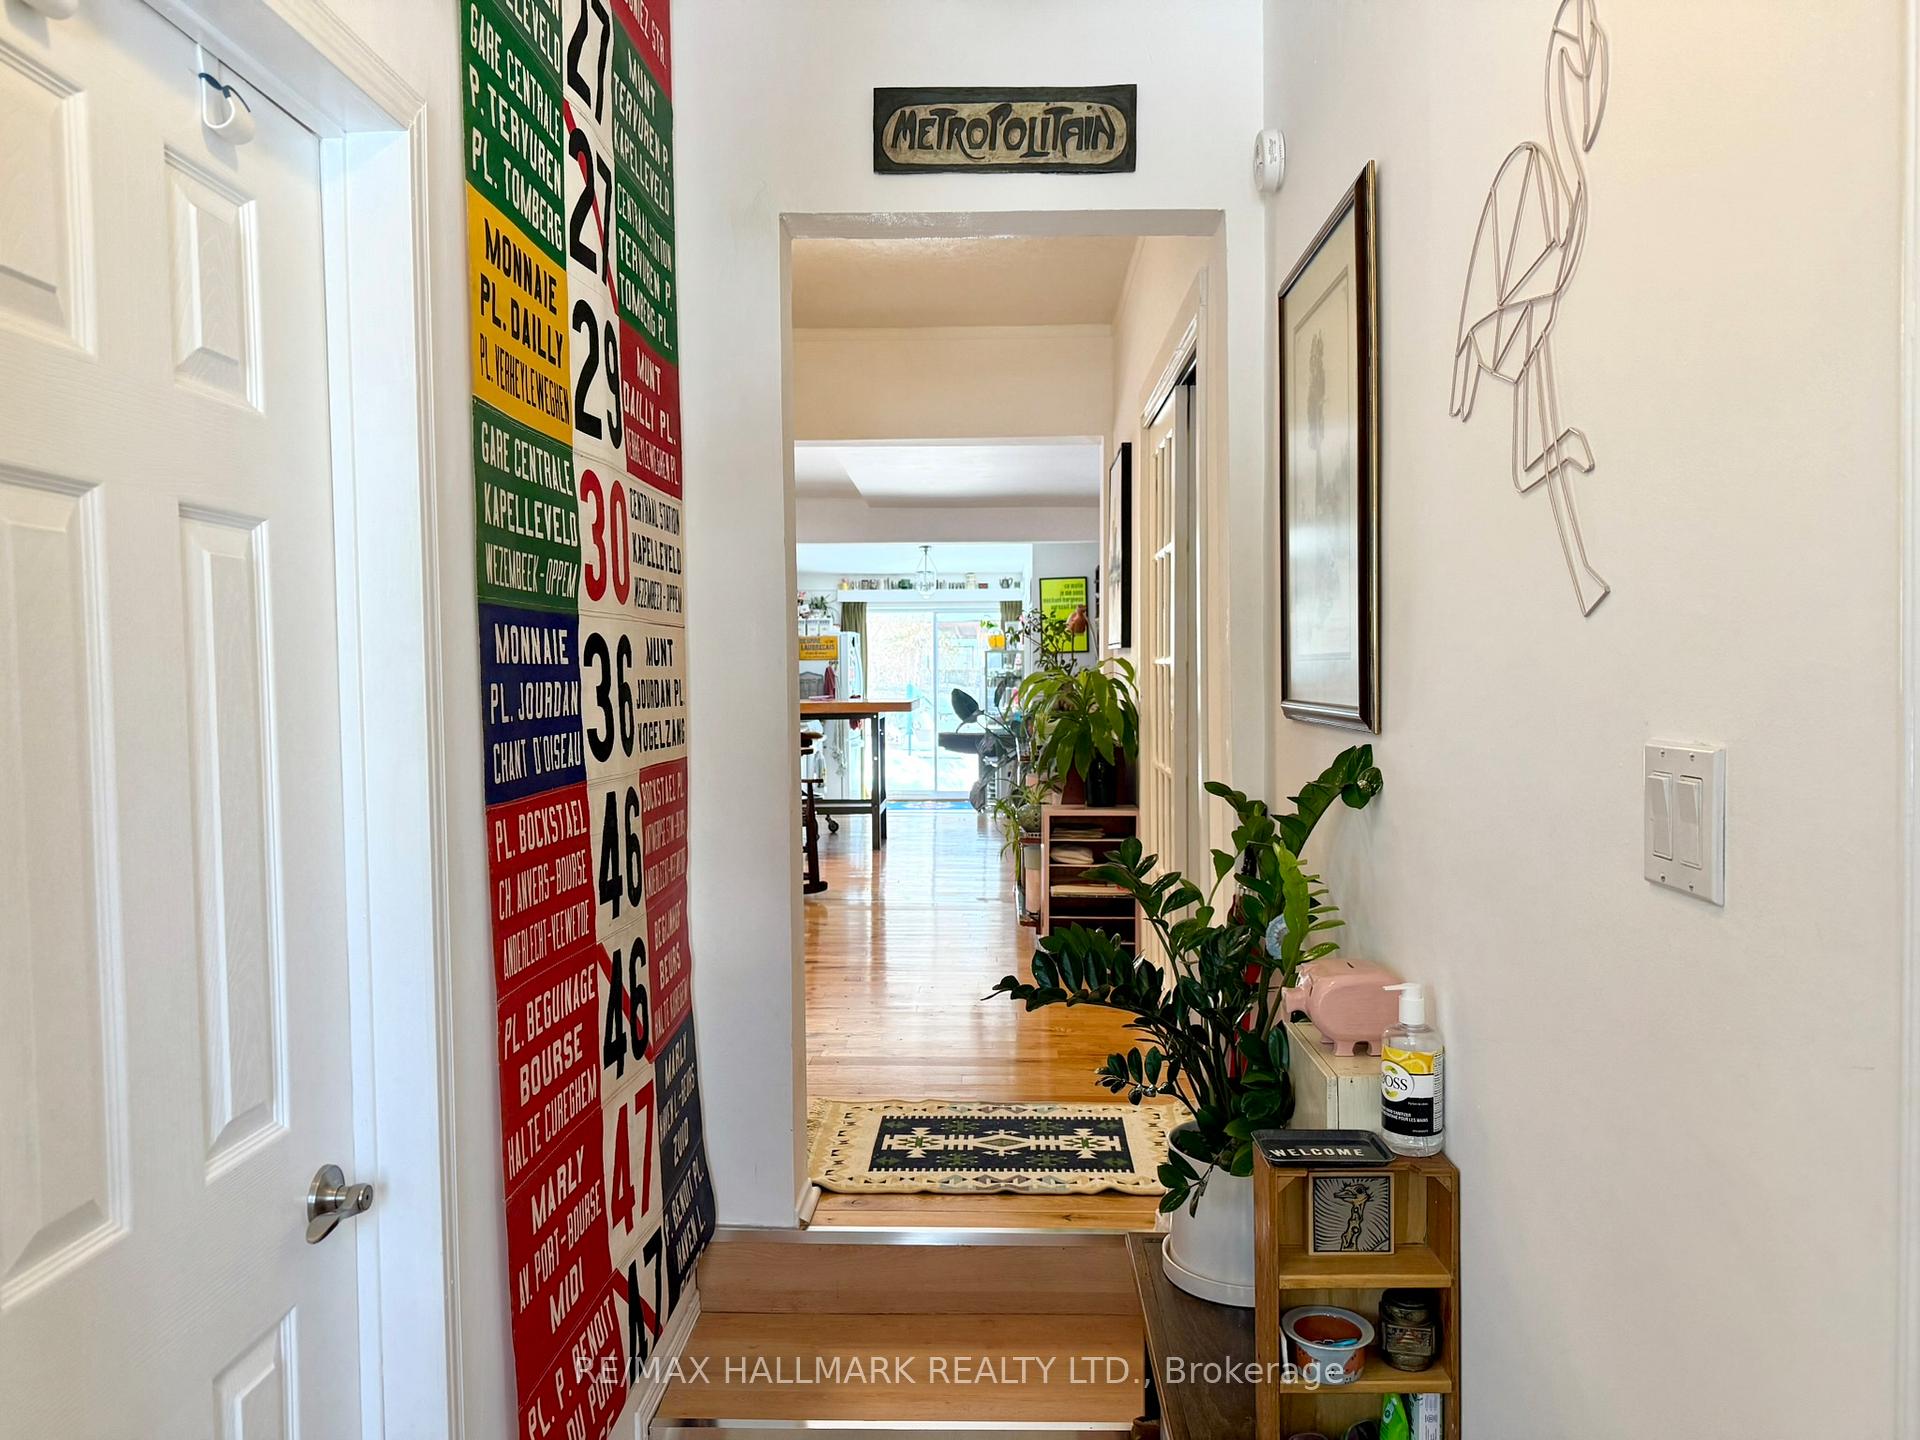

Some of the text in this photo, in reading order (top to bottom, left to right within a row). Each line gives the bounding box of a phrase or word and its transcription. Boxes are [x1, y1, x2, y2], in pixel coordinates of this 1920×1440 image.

[470, 3, 561, 147] GARE CENTRALE
[503, 0, 560, 74] LEVELD
[567, 0, 611, 126] 27
[613, 71, 660, 166] TERVUREN
[627, 49, 656, 116] MUNT
[487, 83, 562, 199] TERVUREN
[614, 117, 669, 216] KAPELLEVELD
[471, 127, 563, 252] PL. TOMBERG
[568, 128, 613, 286] 27
[484, 217, 558, 316] MONNAIE
[618, 228, 661, 302] TERVUREN
[479, 333, 494, 382] PL.
[480, 272, 564, 369] PL. DAILLY
[658, 313, 673, 350] PL.
[572, 299, 623, 450] 29
[636, 346, 661, 395] MUNT
[623, 380, 677, 446] DAILLY PL.
[481, 421, 574, 497] GARE CENTRALE
[483, 482, 578, 547] KAPELLEVELD
[579, 469, 631, 605] 30
[631, 532, 682, 575] KAPELLEVELD
[494, 623, 569, 665] MONNAIE
[645, 636, 673, 667] MUNT
[490, 680, 579, 725] PL. JOURDAN
[583, 632, 635, 763] 36
[636, 679, 672, 709] JOURDAN
[492, 731, 581, 785] CHANT D'OISEAU
[495, 819, 516, 863] PL.
[518, 799, 587, 854] BOCKSTAEL
[599, 785, 643, 920] 46
[498, 877, 514, 921] CH.
[659, 941, 681, 991] BEURS
[504, 1013, 524, 1061] PL.
[526, 963, 596, 1042] BEGUINAGE
[603, 936, 650, 1080] 46
[519, 1022, 583, 1107] BOURSE
[664, 1031, 687, 1089] MARLY
[507, 1063, 597, 1181] HALTE CUREGHEM
[611, 1080, 654, 1236] 47
[1269, 1147, 1365, 1158] WELCOME
[531, 1144, 584, 1235] MARLY
[671, 1168, 694, 1231] BENOIT
[519, 1264, 533, 1314] AV.
[549, 1256, 585, 1334] MIDI
[528, 1396, 555, 1440] PL.
[555, 1367, 572, 1411] P.
[572, 1295, 615, 1383] BENOIT
